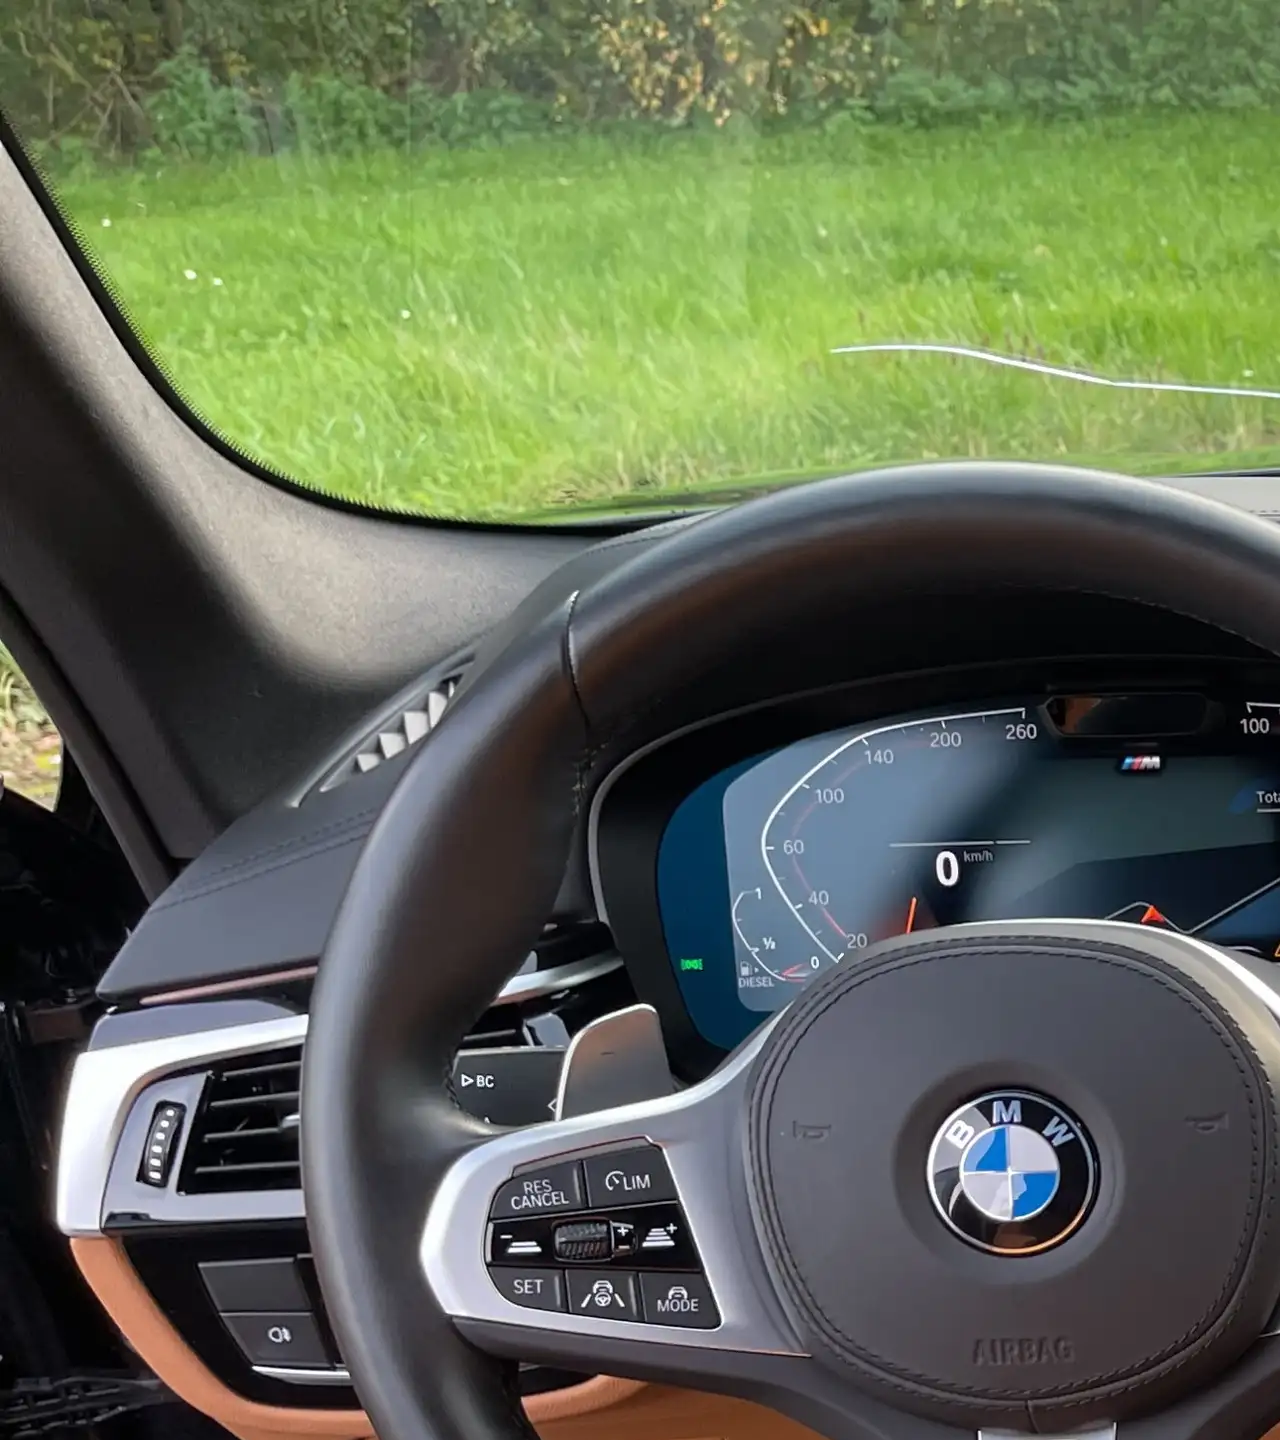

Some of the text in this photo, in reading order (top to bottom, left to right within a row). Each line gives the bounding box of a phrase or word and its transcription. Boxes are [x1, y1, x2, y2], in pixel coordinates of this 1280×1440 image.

[1005, 724, 1037, 740] 260
[1240, 718, 1270, 734] 100
[930, 732, 962, 748] 200
[864, 750, 894, 765] 140
[815, 788, 844, 804] 100
[783, 840, 804, 854] 60
[935, 850, 994, 886] 0 km/h
[755, 888, 762, 899] 1
[808, 890, 830, 906] 40
[846, 933, 868, 950] 20
[810, 956, 820, 969] 0
[738, 976, 775, 988] DIESEL
[476, 1074, 495, 1088] BC
[945, 1100, 1076, 1150] BMW
[523, 1179, 552, 1195] RES
[623, 1174, 651, 1192] LIM
[511, 1191, 569, 1210] CANCEL
[513, 1280, 544, 1296] SET
[657, 1299, 699, 1313] MODE
[972, 1335, 1076, 1366] AIRBAG
